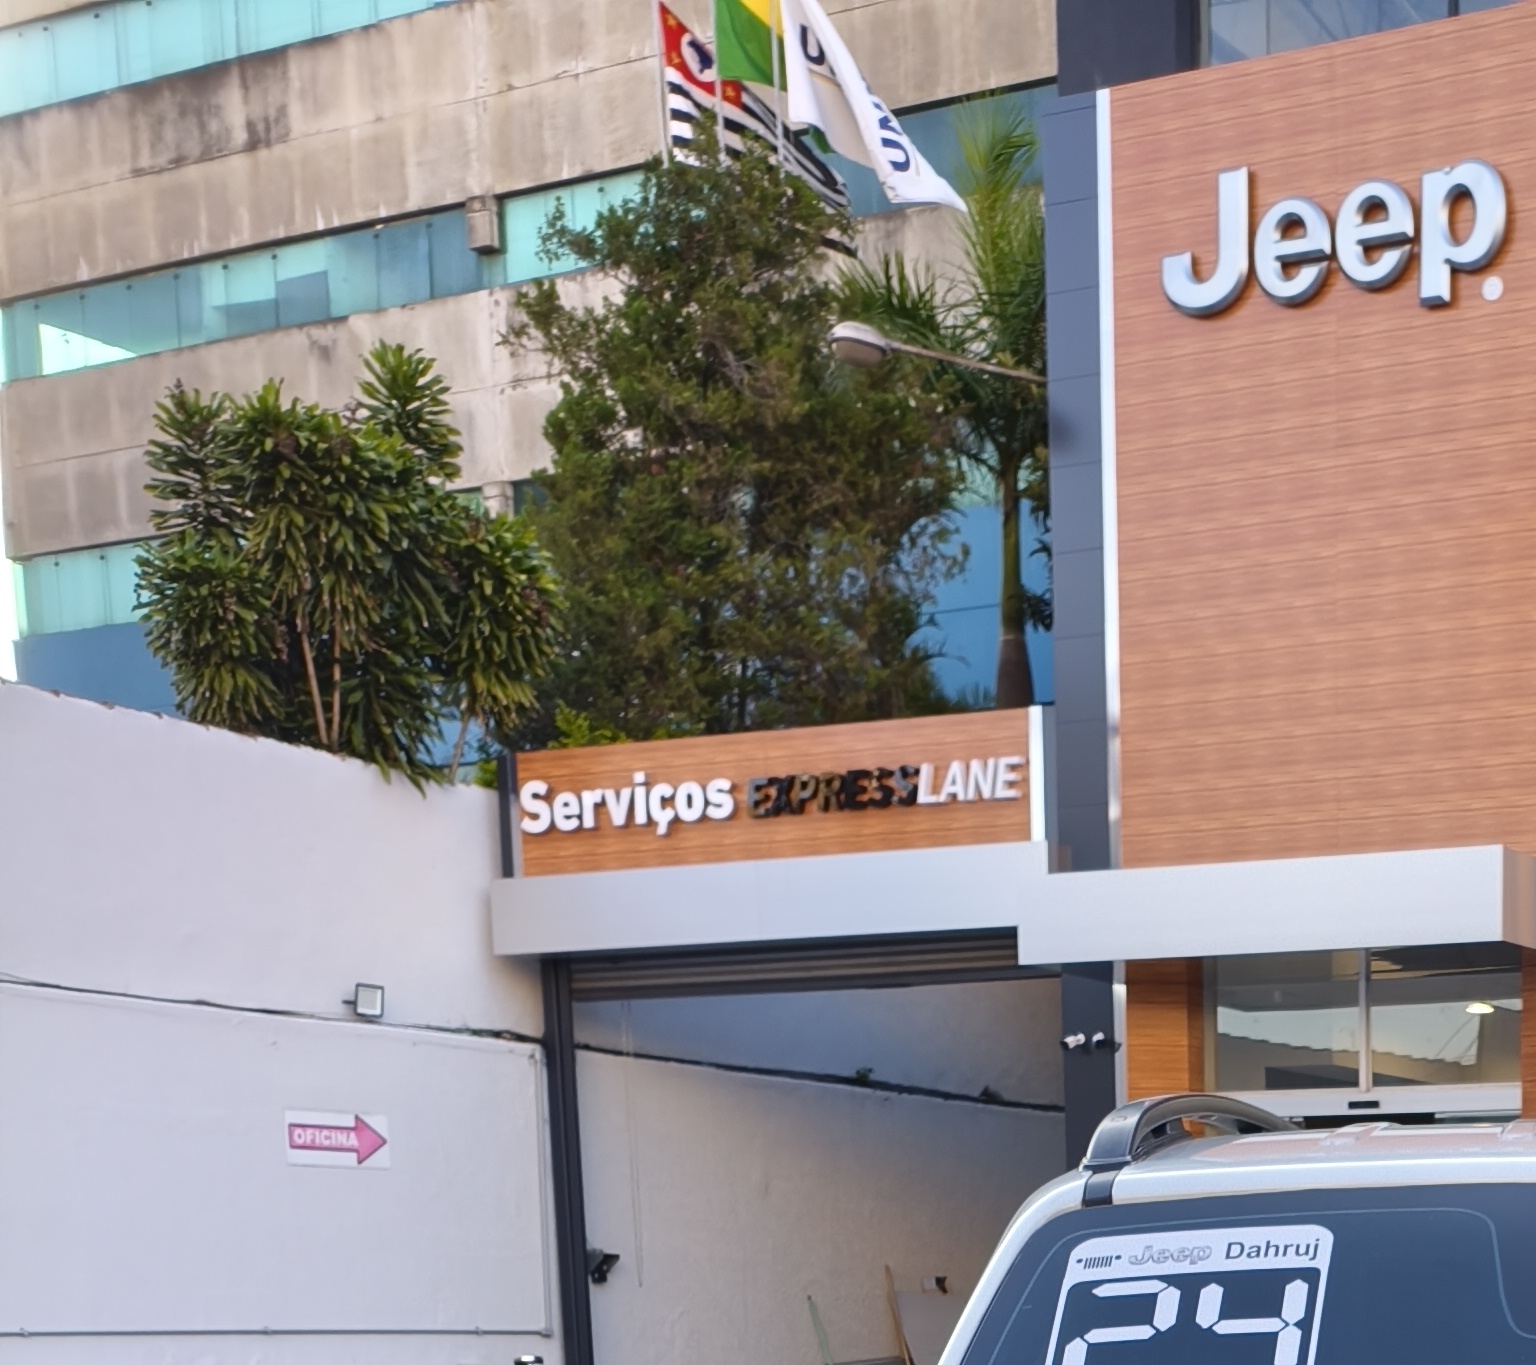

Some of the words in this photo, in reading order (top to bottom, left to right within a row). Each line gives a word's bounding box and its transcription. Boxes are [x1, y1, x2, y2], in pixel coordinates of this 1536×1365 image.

[1161, 158, 1508, 319] Jeep
[519, 771, 735, 836] Serviços
[916, 755, 1025, 805] LANE
[293, 1128, 358, 1148] OFICINA
[1128, 1244, 1213, 1266] Jeep
[1224, 1238, 1321, 1262] Dahruj
